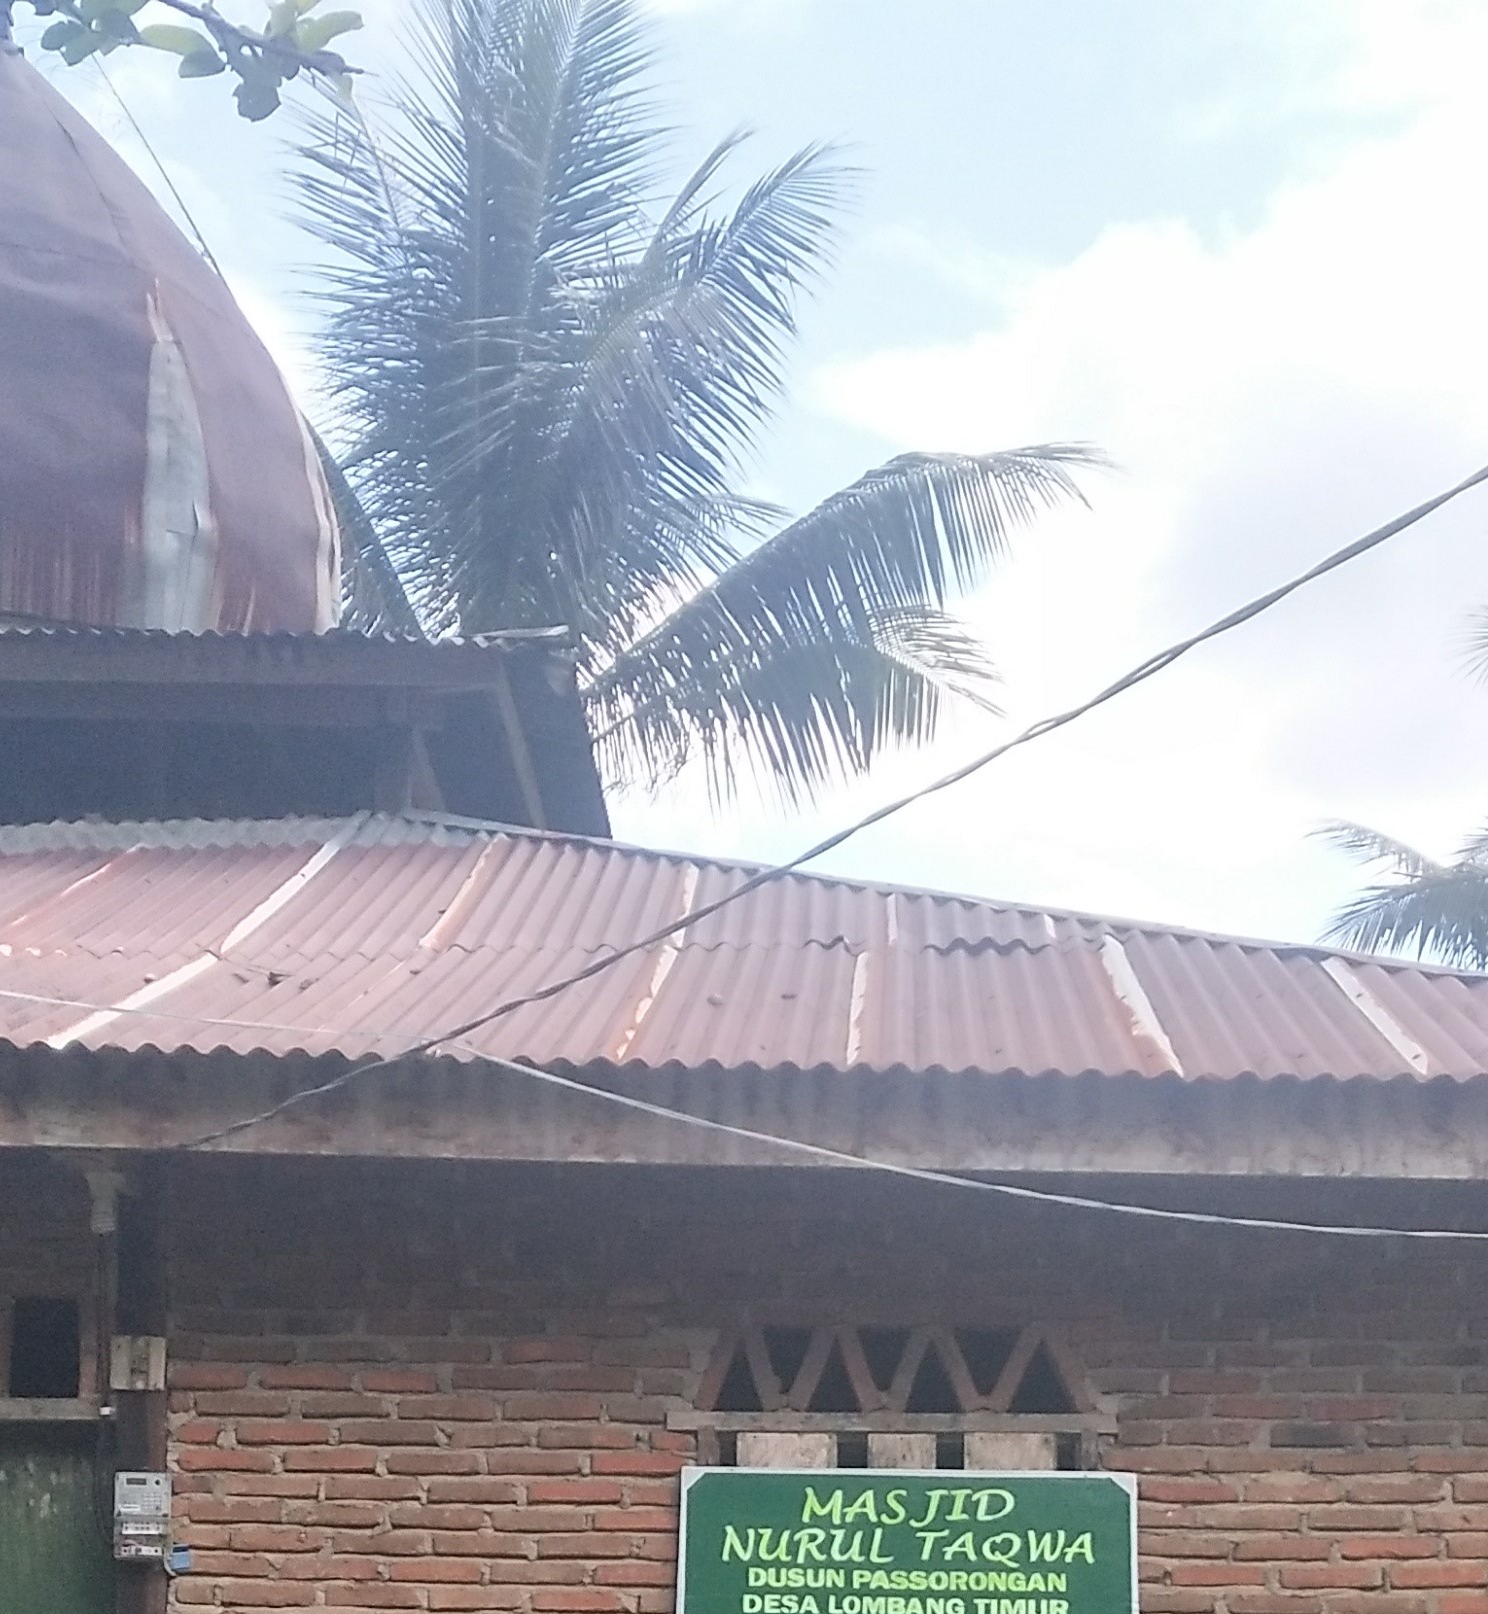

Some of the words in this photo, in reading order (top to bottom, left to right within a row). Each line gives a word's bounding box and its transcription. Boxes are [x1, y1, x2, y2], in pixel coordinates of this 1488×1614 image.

[721, 1525, 894, 1564] NURUL
[914, 1529, 1096, 1568] TAQWA
[747, 1567, 845, 1588] DUSUN
[851, 1569, 1067, 1592] PASSORONGAN
[741, 1594, 820, 1614] DESA
